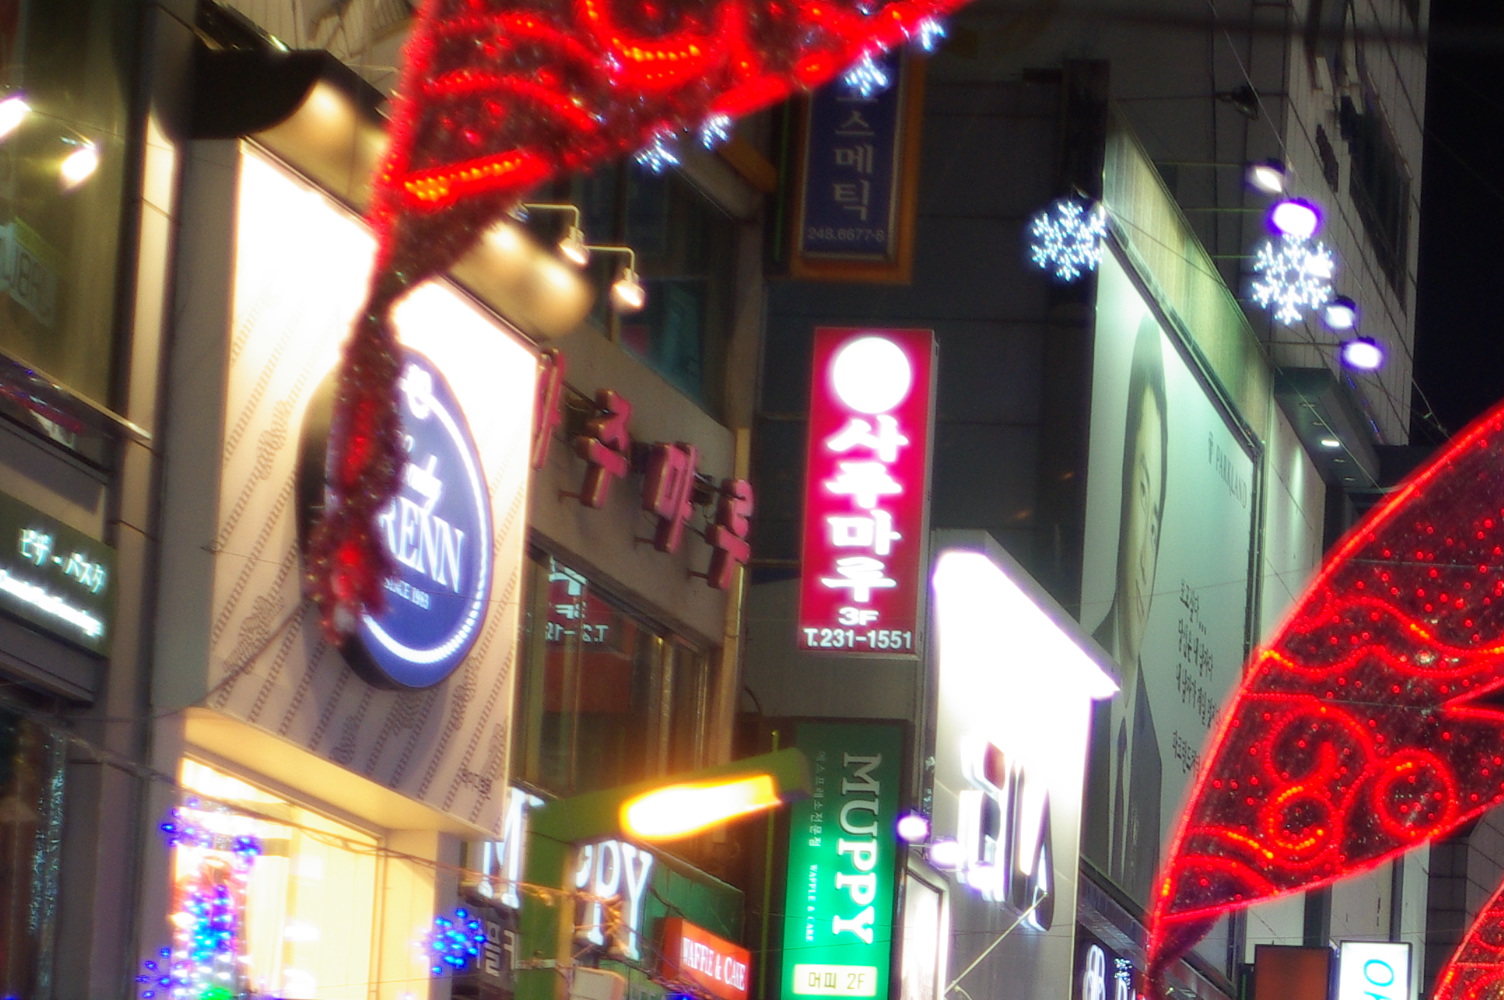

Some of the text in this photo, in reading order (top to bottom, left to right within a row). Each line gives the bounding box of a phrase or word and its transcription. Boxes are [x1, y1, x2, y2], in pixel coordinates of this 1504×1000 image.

[833, 94, 879, 222] 스메틱
[821, 414, 909, 603] 사주마루
[838, 606, 880, 627] 3F
[803, 628, 913, 650] T.231-1551
[832, 752, 882, 945] MUPPY
[807, 864, 819, 906] WAFFLE
[682, 938, 715, 979] WAFFLE
